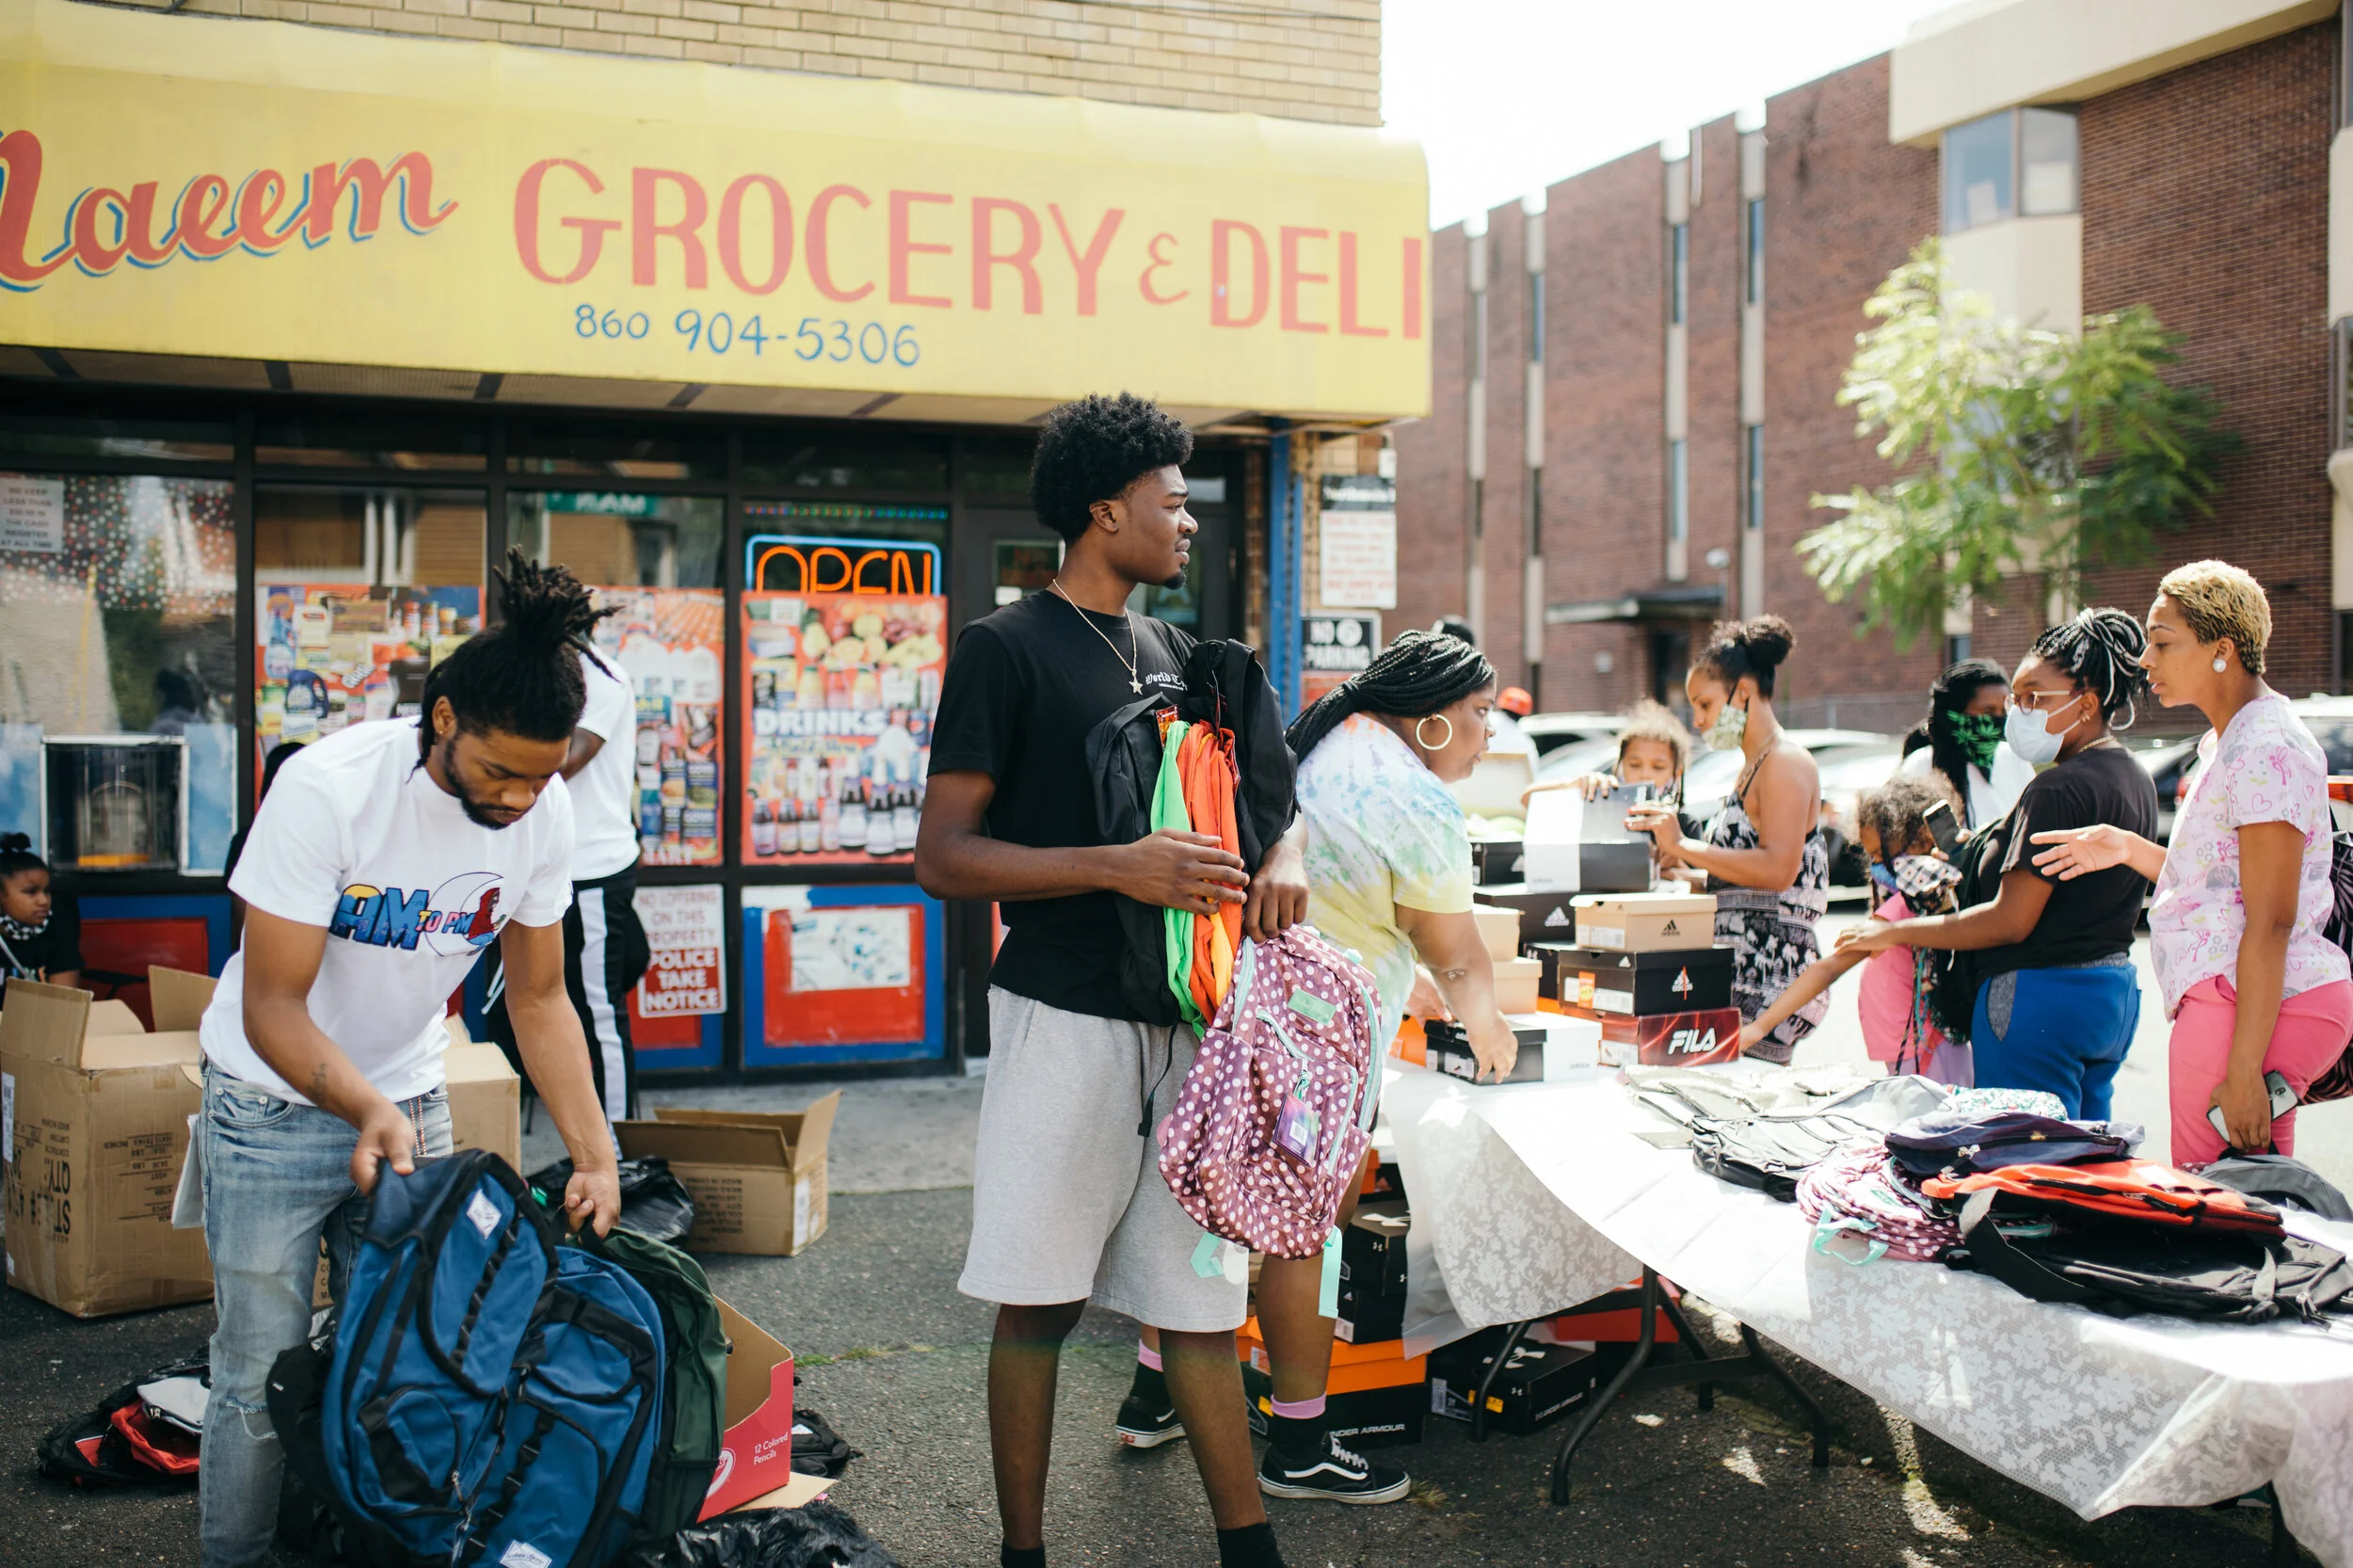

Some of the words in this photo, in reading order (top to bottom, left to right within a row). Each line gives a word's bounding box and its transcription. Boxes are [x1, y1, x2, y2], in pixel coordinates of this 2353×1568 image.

[514, 157, 1127, 317] GROCERY
[1209, 218, 1422, 340] DELI
[575, 303, 649, 340] 860
[674, 309, 920, 367] 904-5306
[756, 545, 932, 595] OPEN
[754, 709, 886, 736] DRINKS
[328, 884, 429, 951] AM
[415, 910, 443, 933] TO
[441, 911, 476, 935] PM
[651, 911, 672, 927] ON
[678, 909, 706, 924] THIS
[649, 949, 717, 969] POLICE
[656, 968, 707, 989] TAKE
[646, 988, 720, 1012] NOTICE
[1668, 1027, 1717, 1056] FILA
[1360, 1423, 1405, 1435] ARMOUR
[754, 1444, 761, 1454] 12
[762, 1432, 789, 1450] Colored
[754, 1448, 776, 1465] Pencils
